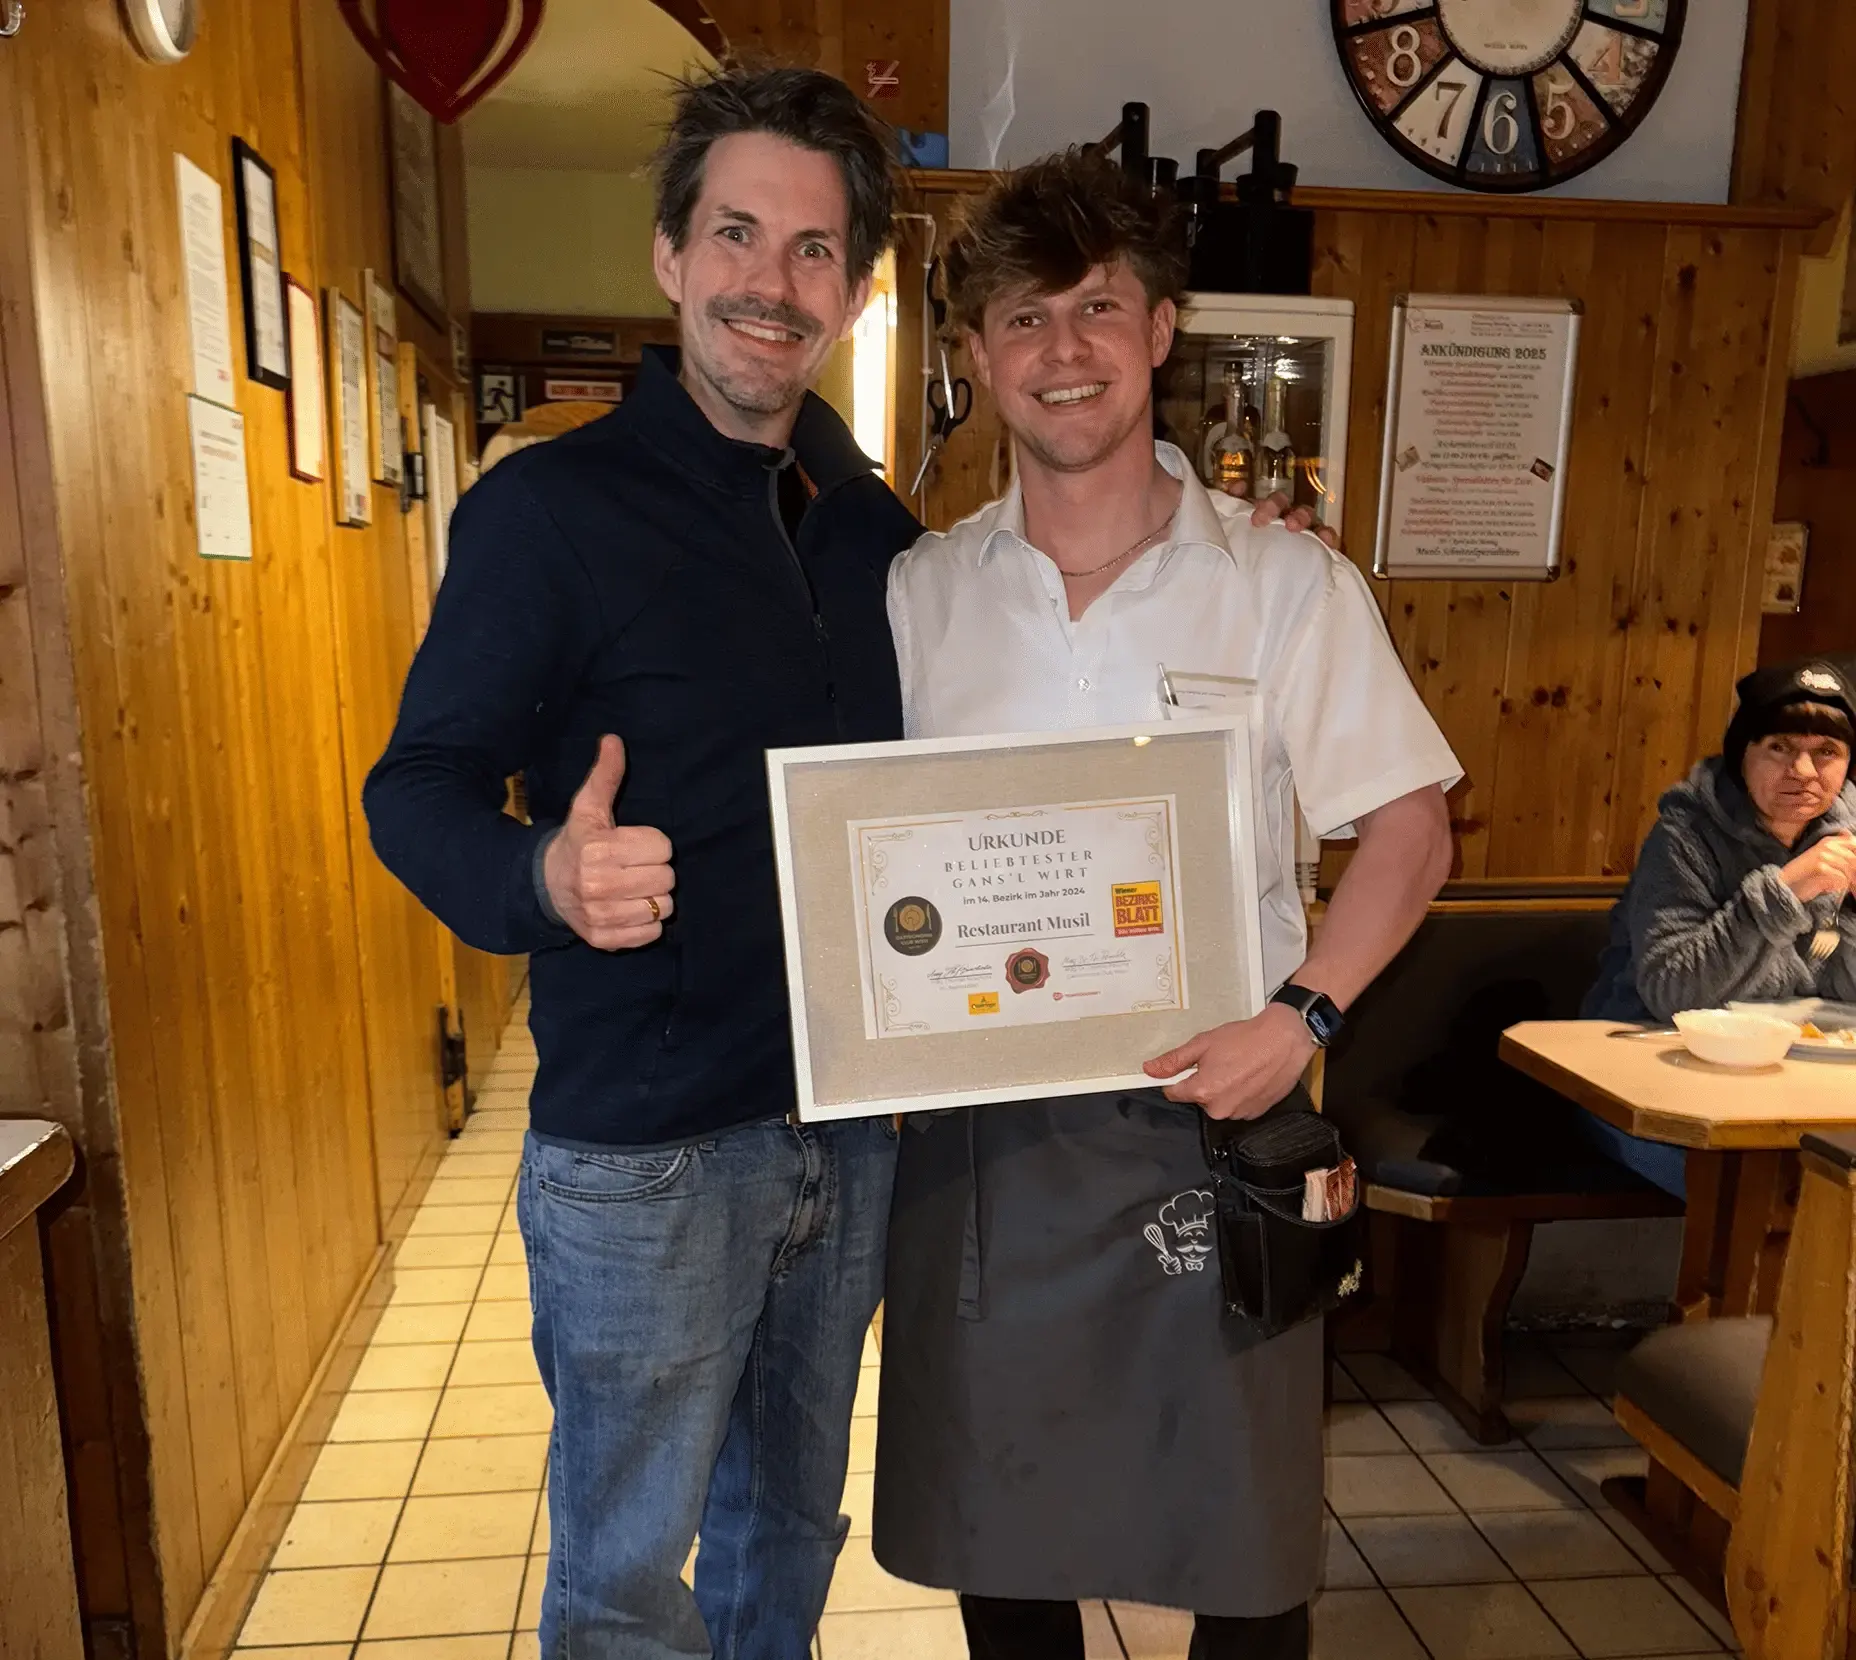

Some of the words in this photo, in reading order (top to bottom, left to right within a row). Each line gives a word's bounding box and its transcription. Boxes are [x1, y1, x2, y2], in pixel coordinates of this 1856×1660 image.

[1386, 25, 1421, 87] 8
[1588, 33, 1627, 86] 4
[1436, 82, 1467, 139] 7
[1541, 79, 1576, 139] 5
[1484, 90, 1519, 154] 6
[1420, 342, 1511, 359] ANKÜNDIGUNG
[1515, 347, 1547, 360] 2025
[968, 829, 1066, 851] URKUNDE
[944, 850, 1093, 872] BELIEBTESTER
[952, 872, 1026, 889] GANS'L
[1037, 867, 1088, 881] WIRT
[963, 896, 976, 905] im
[977, 895, 991, 904] 14.
[992, 892, 1023, 902] Bezirk
[1024, 891, 1037, 900] im
[1039, 889, 1060, 898] Jahr
[1062, 887, 1086, 896] 2024
[1115, 893, 1159, 907] BEZIRKS
[957, 917, 1043, 939] Restaurant
[1046, 912, 1091, 931] Musil
[1116, 905, 1160, 924] BLATT
